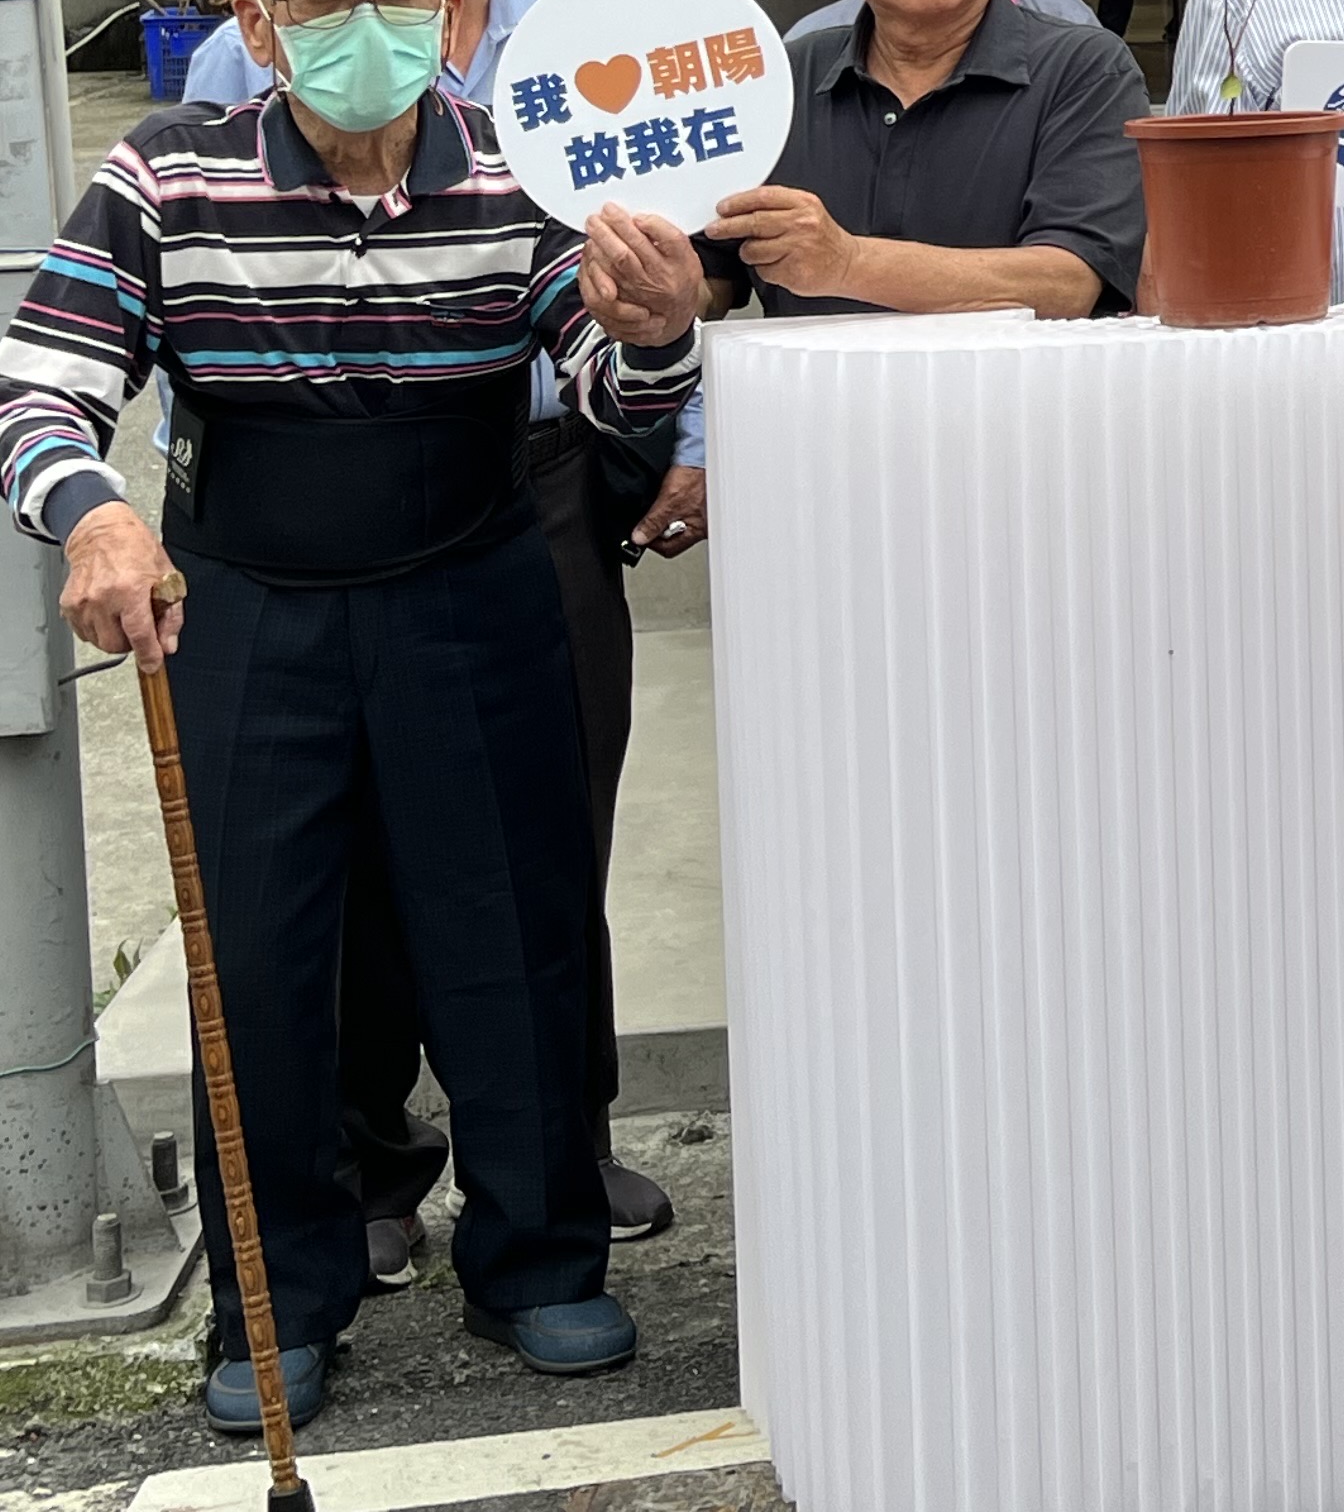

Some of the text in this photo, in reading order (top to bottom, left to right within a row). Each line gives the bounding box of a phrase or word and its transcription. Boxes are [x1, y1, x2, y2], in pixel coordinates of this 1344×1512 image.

[510, 27, 767, 133] 我 朝陽
[564, 105, 745, 192] 故我在
